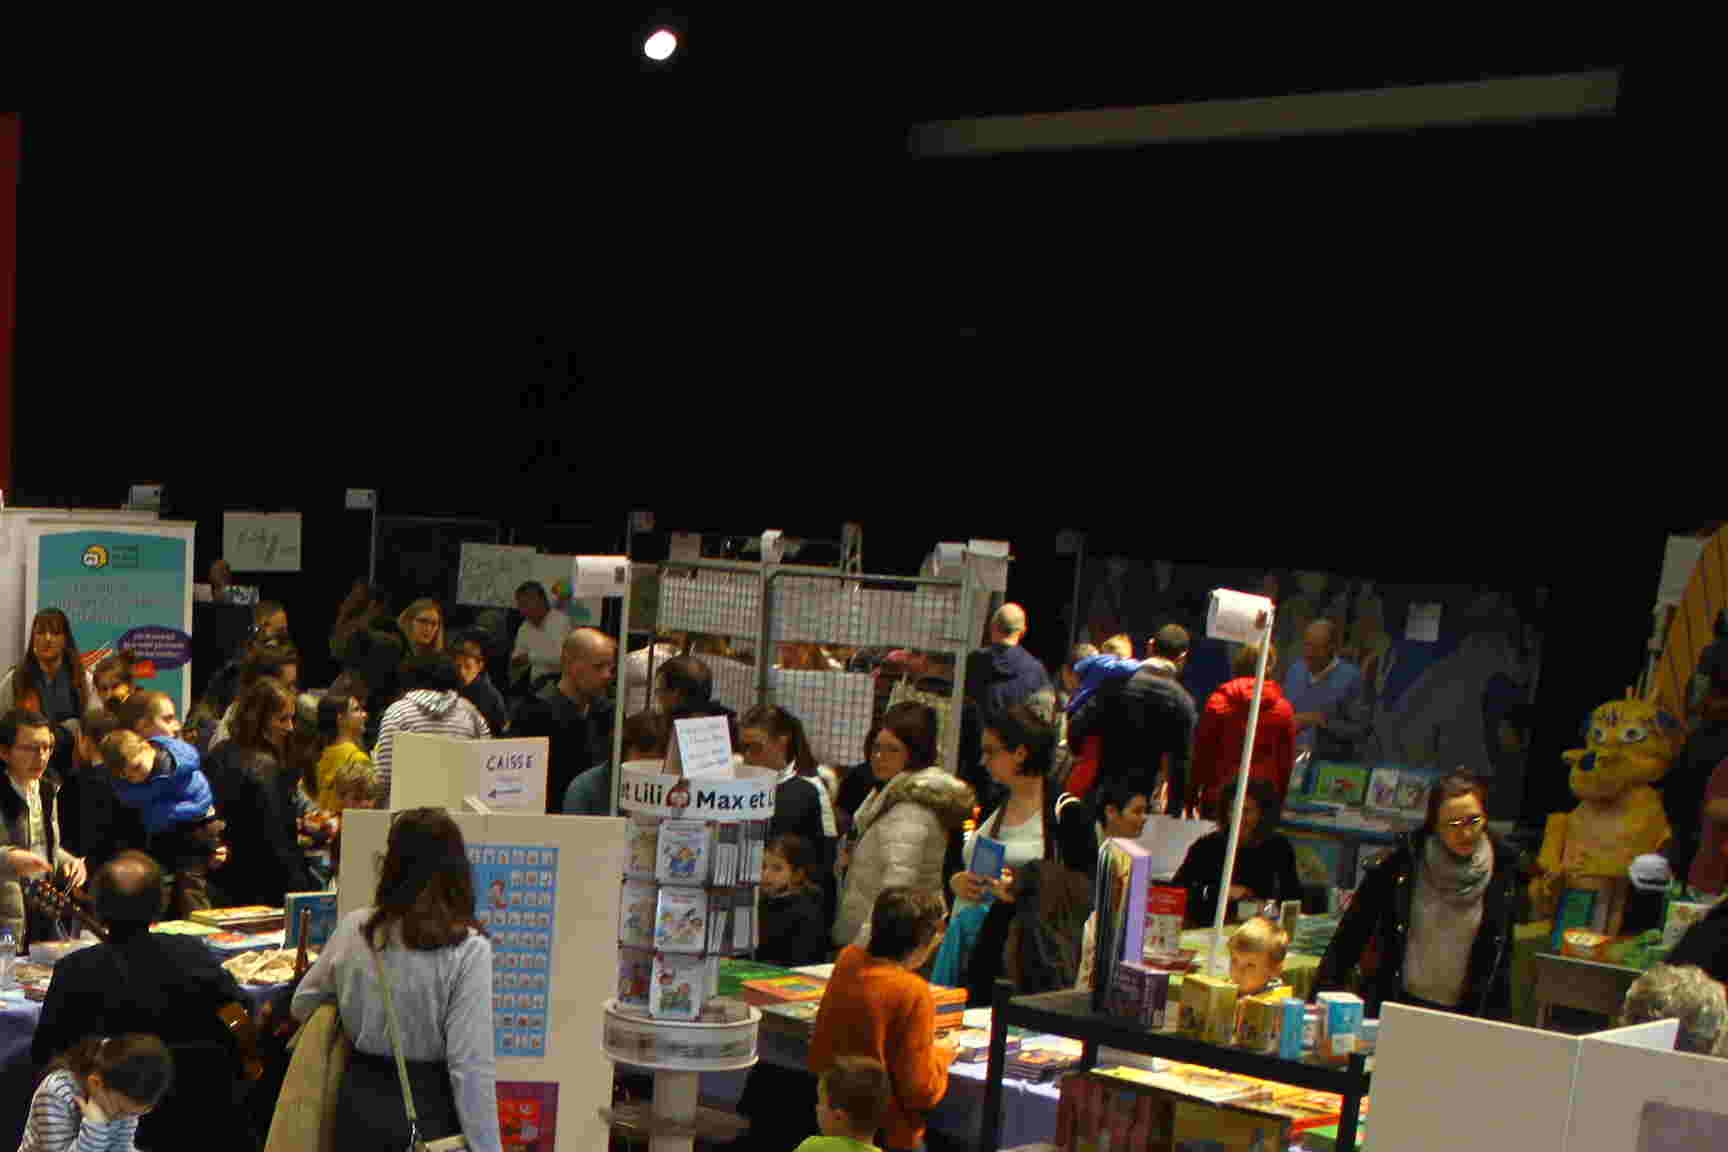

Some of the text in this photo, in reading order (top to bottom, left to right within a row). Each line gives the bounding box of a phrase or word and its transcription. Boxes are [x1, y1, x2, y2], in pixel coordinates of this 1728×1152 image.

[485, 752, 536, 772] CAISSE
[634, 783, 664, 805] Lili
[696, 789, 744, 809] Max
[749, 791, 765, 808] et
